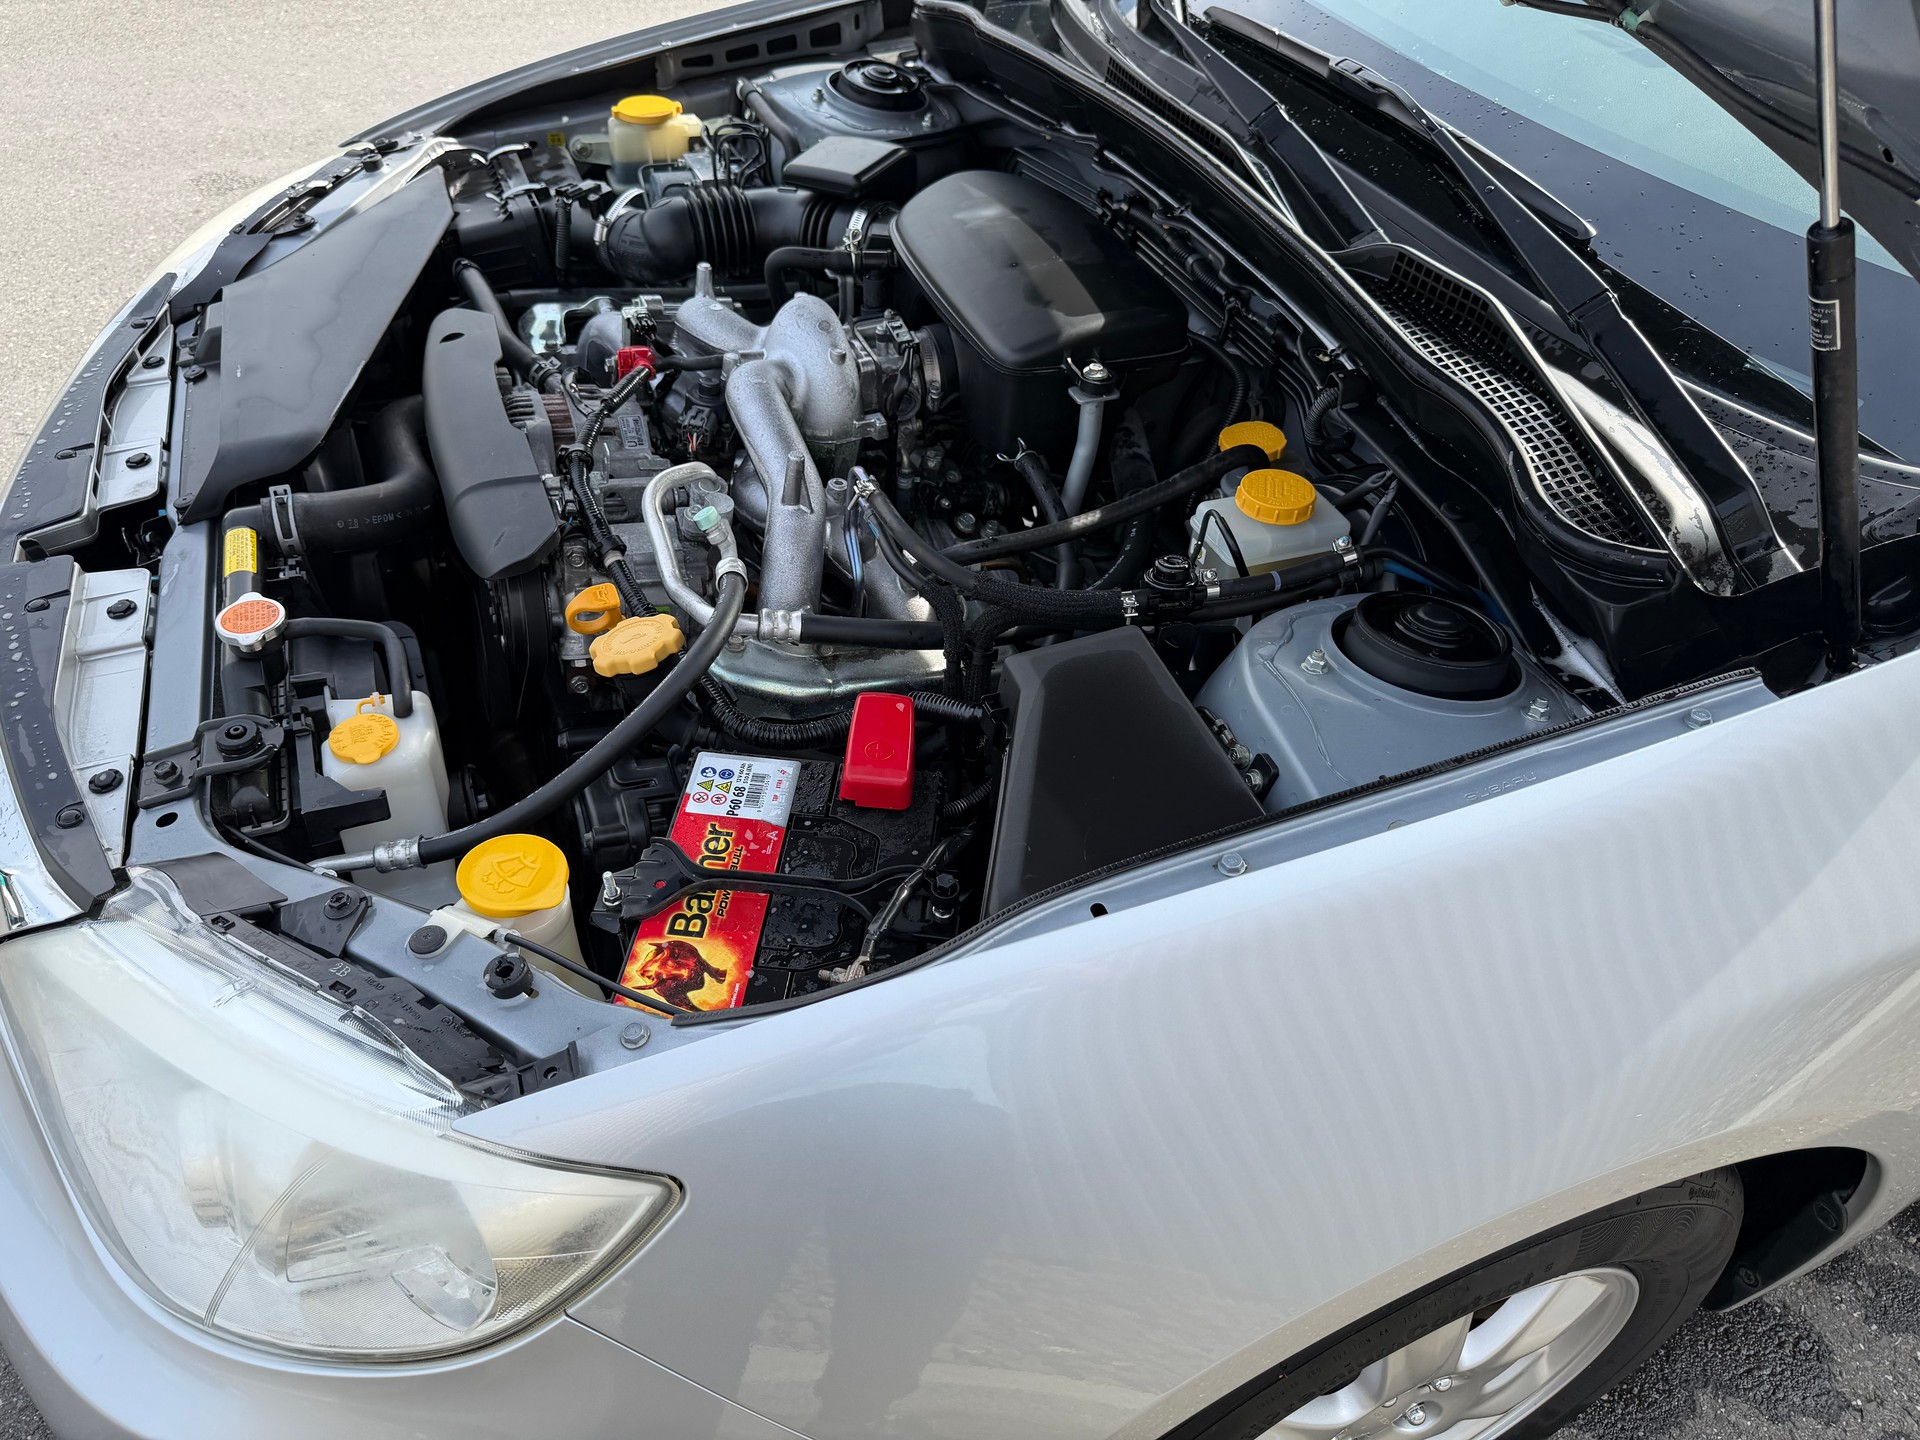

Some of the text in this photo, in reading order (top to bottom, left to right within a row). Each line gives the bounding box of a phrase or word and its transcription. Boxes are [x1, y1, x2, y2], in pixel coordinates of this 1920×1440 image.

[726, 786, 746, 816] P60 68
[1464, 771, 1537, 801] SUBARU
[666, 823, 734, 939] Baner
